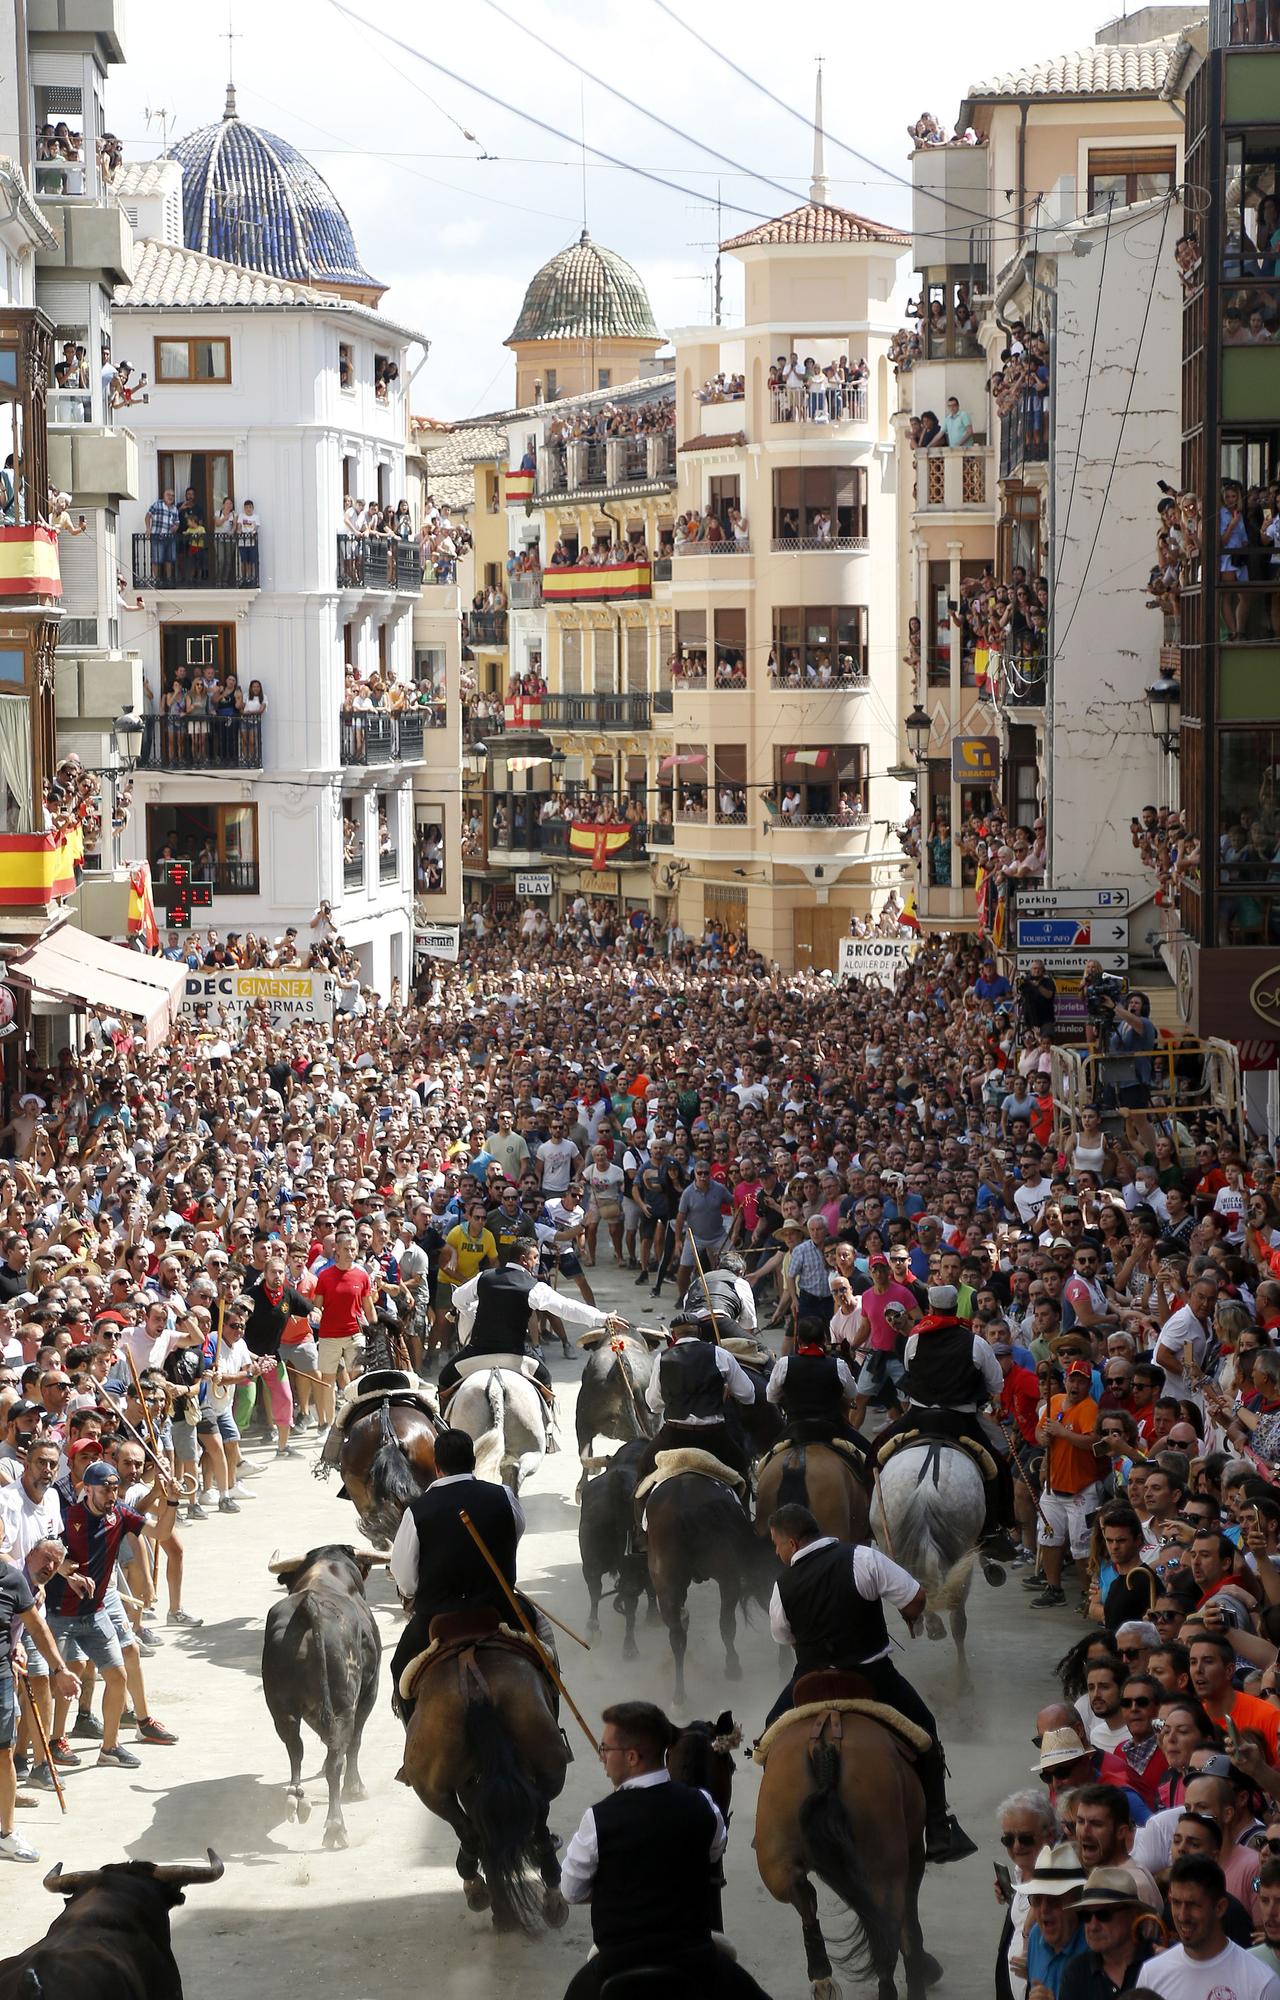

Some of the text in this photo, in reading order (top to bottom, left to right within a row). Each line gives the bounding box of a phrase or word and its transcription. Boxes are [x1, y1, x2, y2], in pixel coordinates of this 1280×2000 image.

[518, 883, 550, 893] BLAY
[1018, 895, 1058, 905] parking
[1019, 957, 1088, 967] aytamiento
[238, 979, 311, 997] GIMENEZ
[461, 1242, 484, 1252] PUMA
